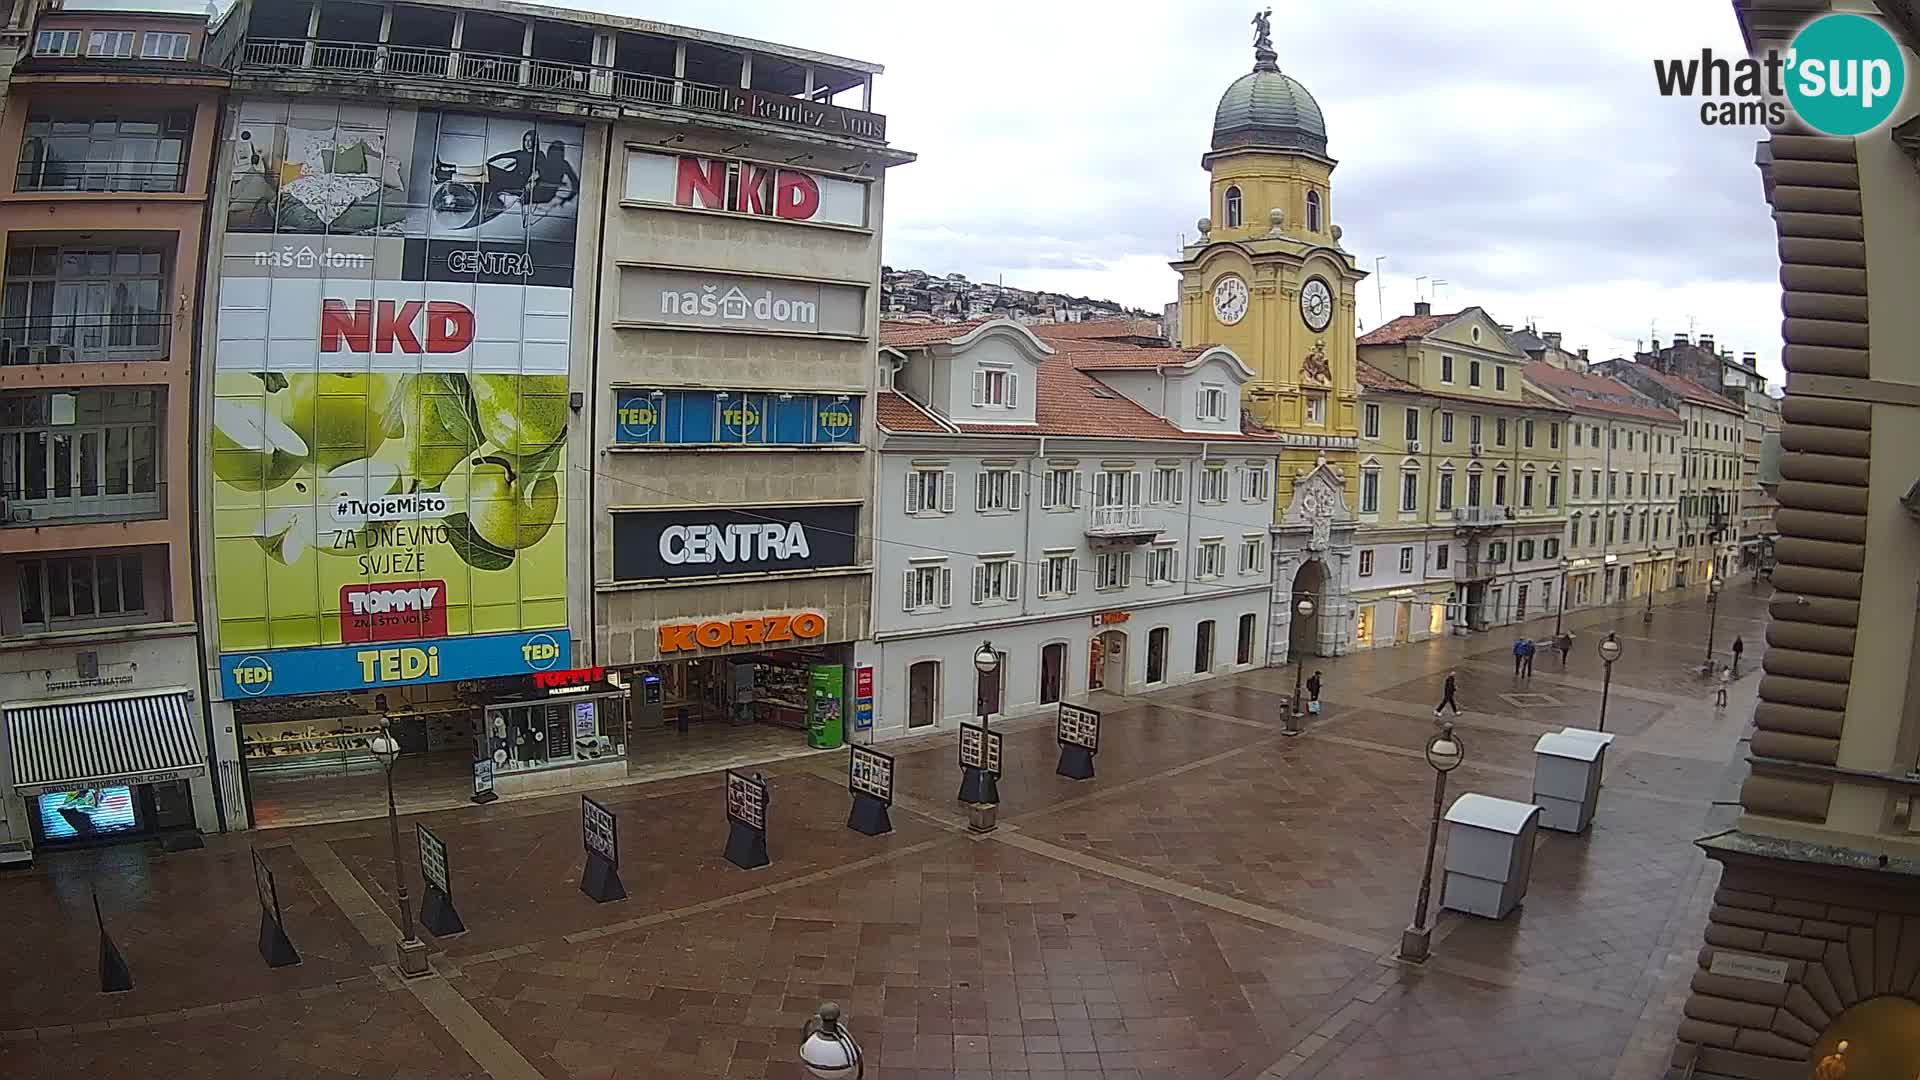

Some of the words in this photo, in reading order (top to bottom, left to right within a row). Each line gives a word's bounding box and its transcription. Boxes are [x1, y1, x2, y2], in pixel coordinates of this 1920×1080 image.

[675, 158, 820, 220] NKD
[254, 247, 292, 268] naš
[319, 247, 366, 269] dom
[447, 250, 534, 276] CENTRA
[660, 284, 717, 317] naš
[754, 290, 817, 324] dom
[320, 297, 477, 354] NKD
[618, 408, 657, 426] TEDi
[723, 408, 760, 426] TEDi
[819, 411, 853, 427] TEDi
[337, 498, 446, 517] #TvojeMisto
[333, 529, 357, 550] ZA
[365, 524, 450, 549] DNEVNO
[659, 521, 811, 565] CENTRA
[358, 547, 426, 576] SVJEŽE
[348, 587, 439, 615] TOMMY
[659, 612, 825, 654] KORZO
[357, 646, 440, 683] TEDi
[521, 643, 560, 663] TEDi
[233, 666, 273, 685] TEDi
